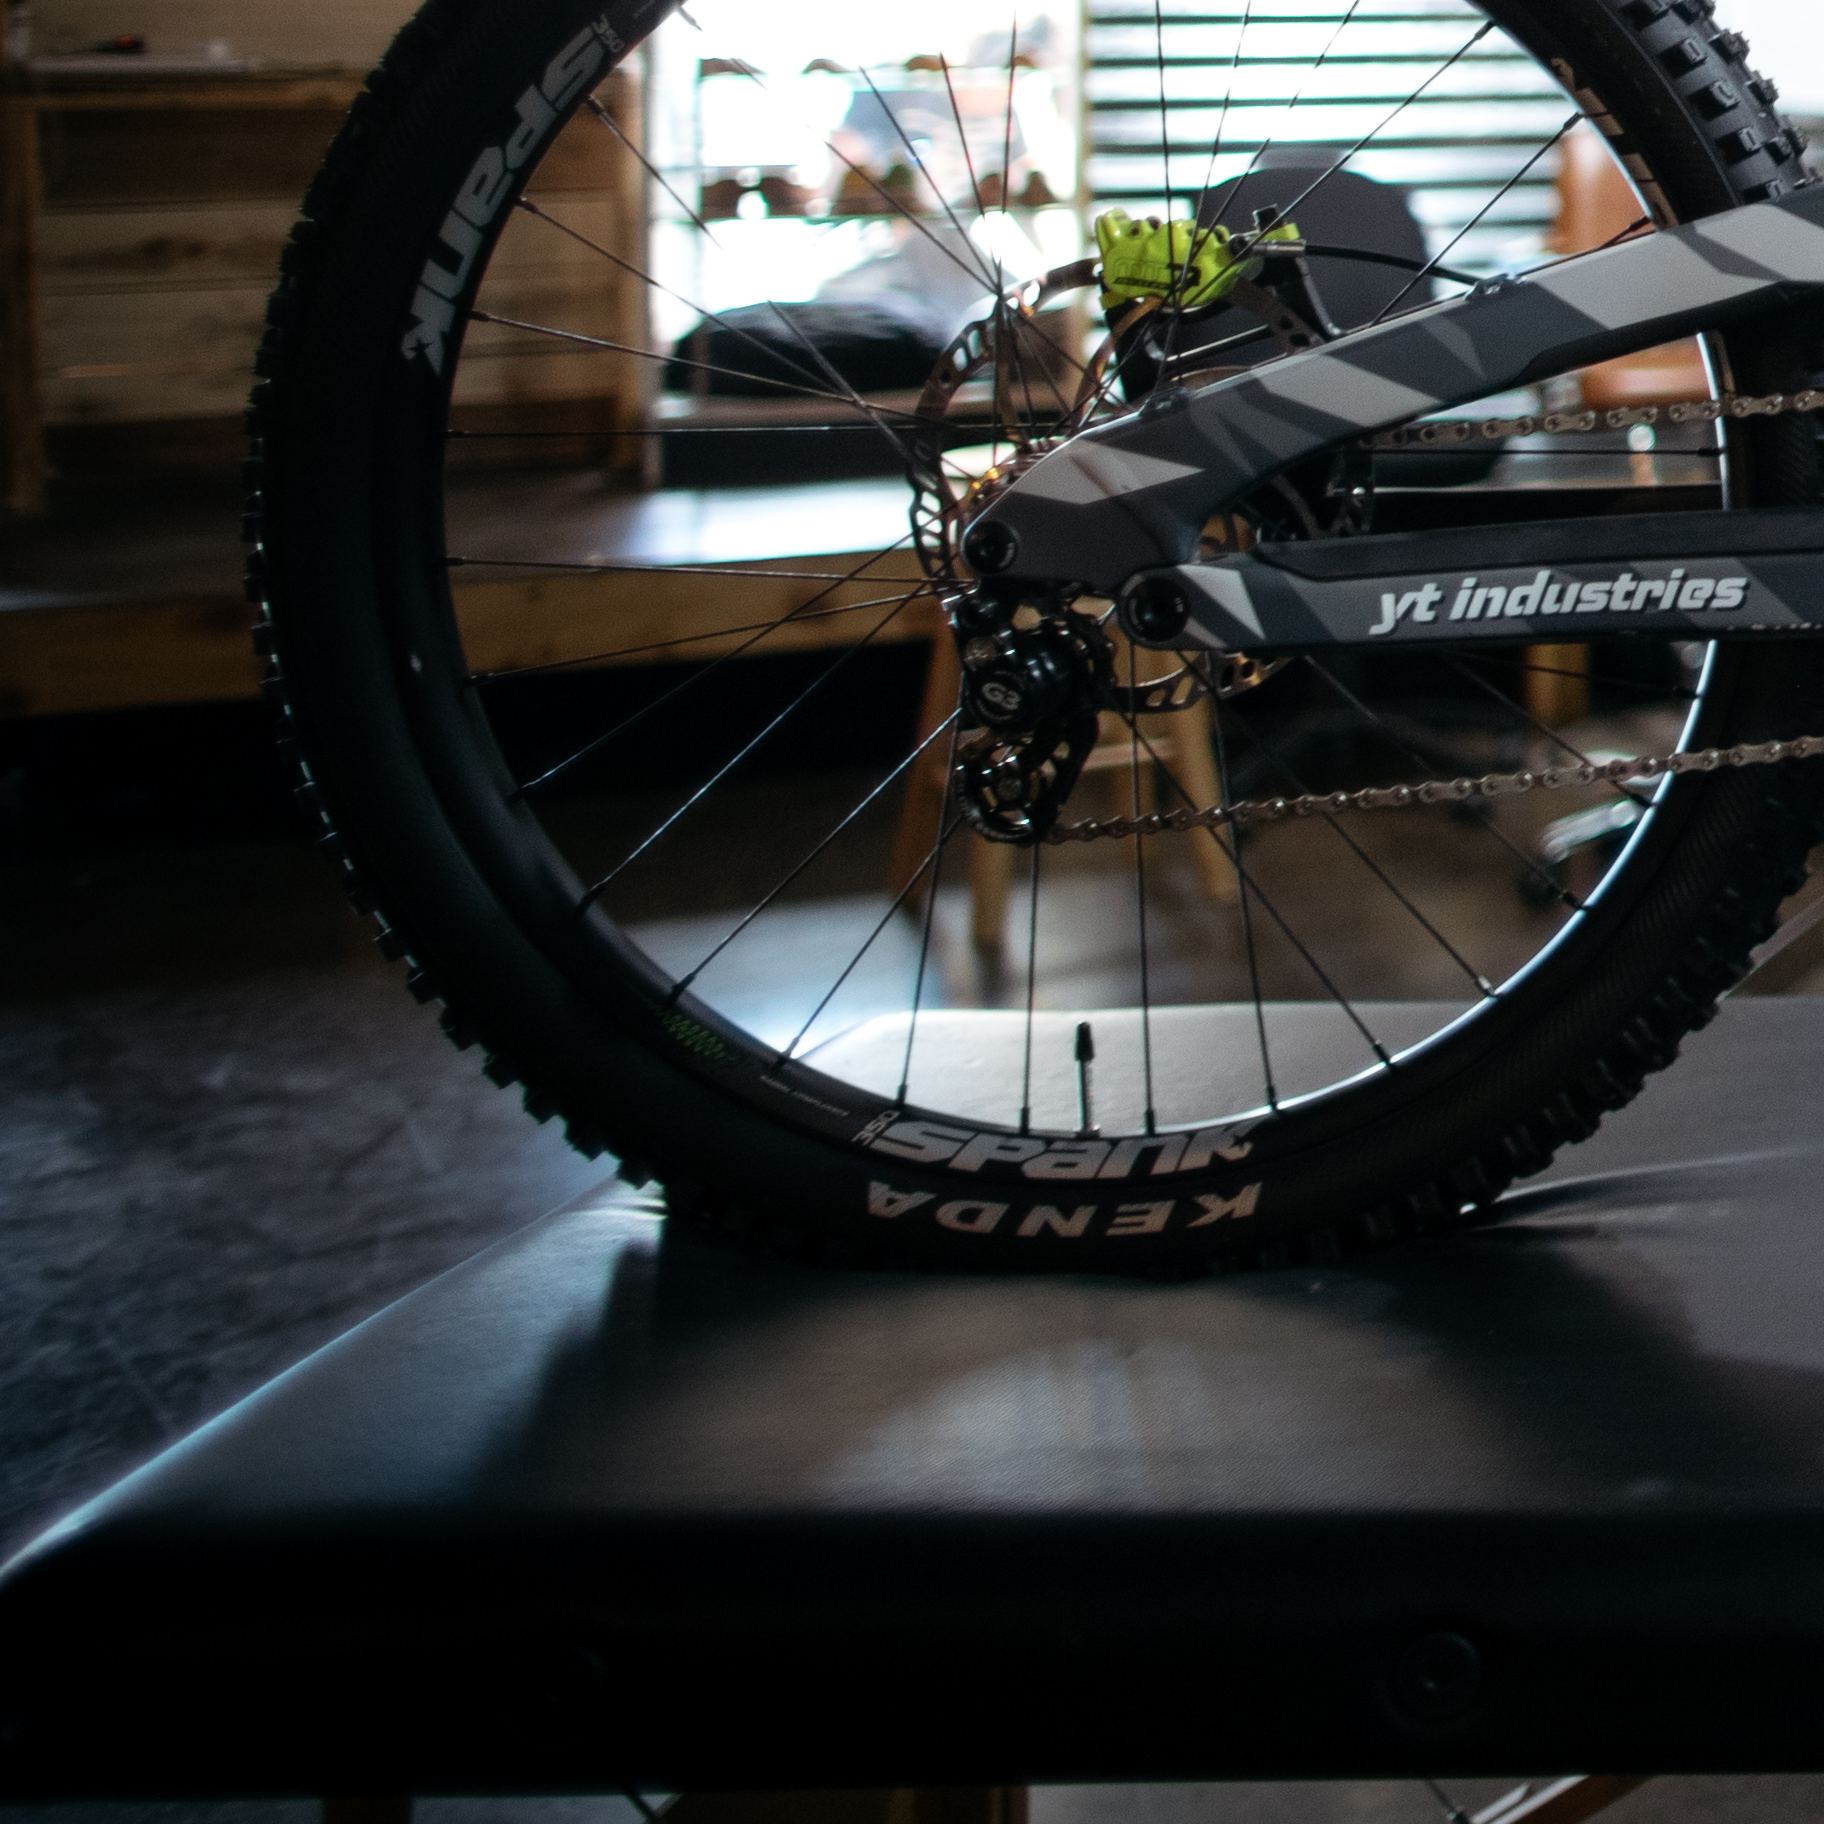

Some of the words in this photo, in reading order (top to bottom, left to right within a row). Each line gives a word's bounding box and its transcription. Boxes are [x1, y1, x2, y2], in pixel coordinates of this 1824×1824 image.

[1368, 582, 1442, 635] yt
[1448, 568, 1748, 621] industries
[982, 682, 1021, 710] G3
[866, 1181, 1263, 1238] KENDA
